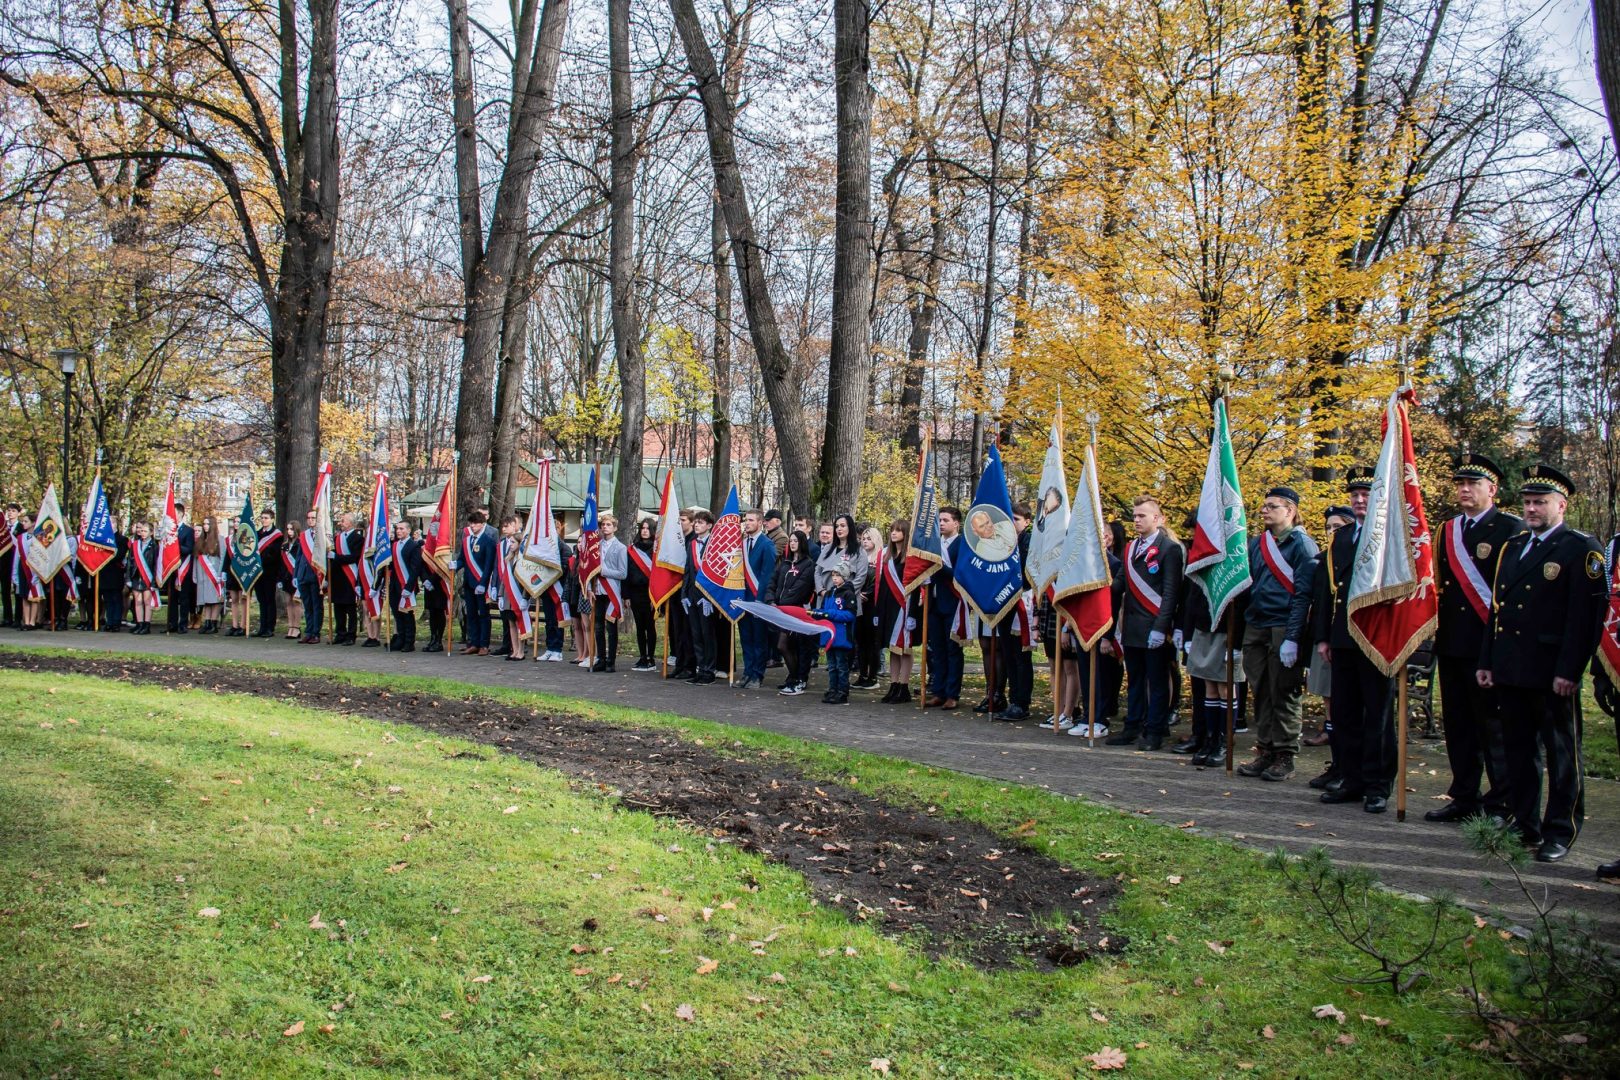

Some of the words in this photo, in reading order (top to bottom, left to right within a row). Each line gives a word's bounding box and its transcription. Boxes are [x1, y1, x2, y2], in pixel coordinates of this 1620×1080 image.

[970, 556, 983, 569] IM.
[986, 562, 1010, 573] JANA
[994, 581, 1015, 605] NOWY
